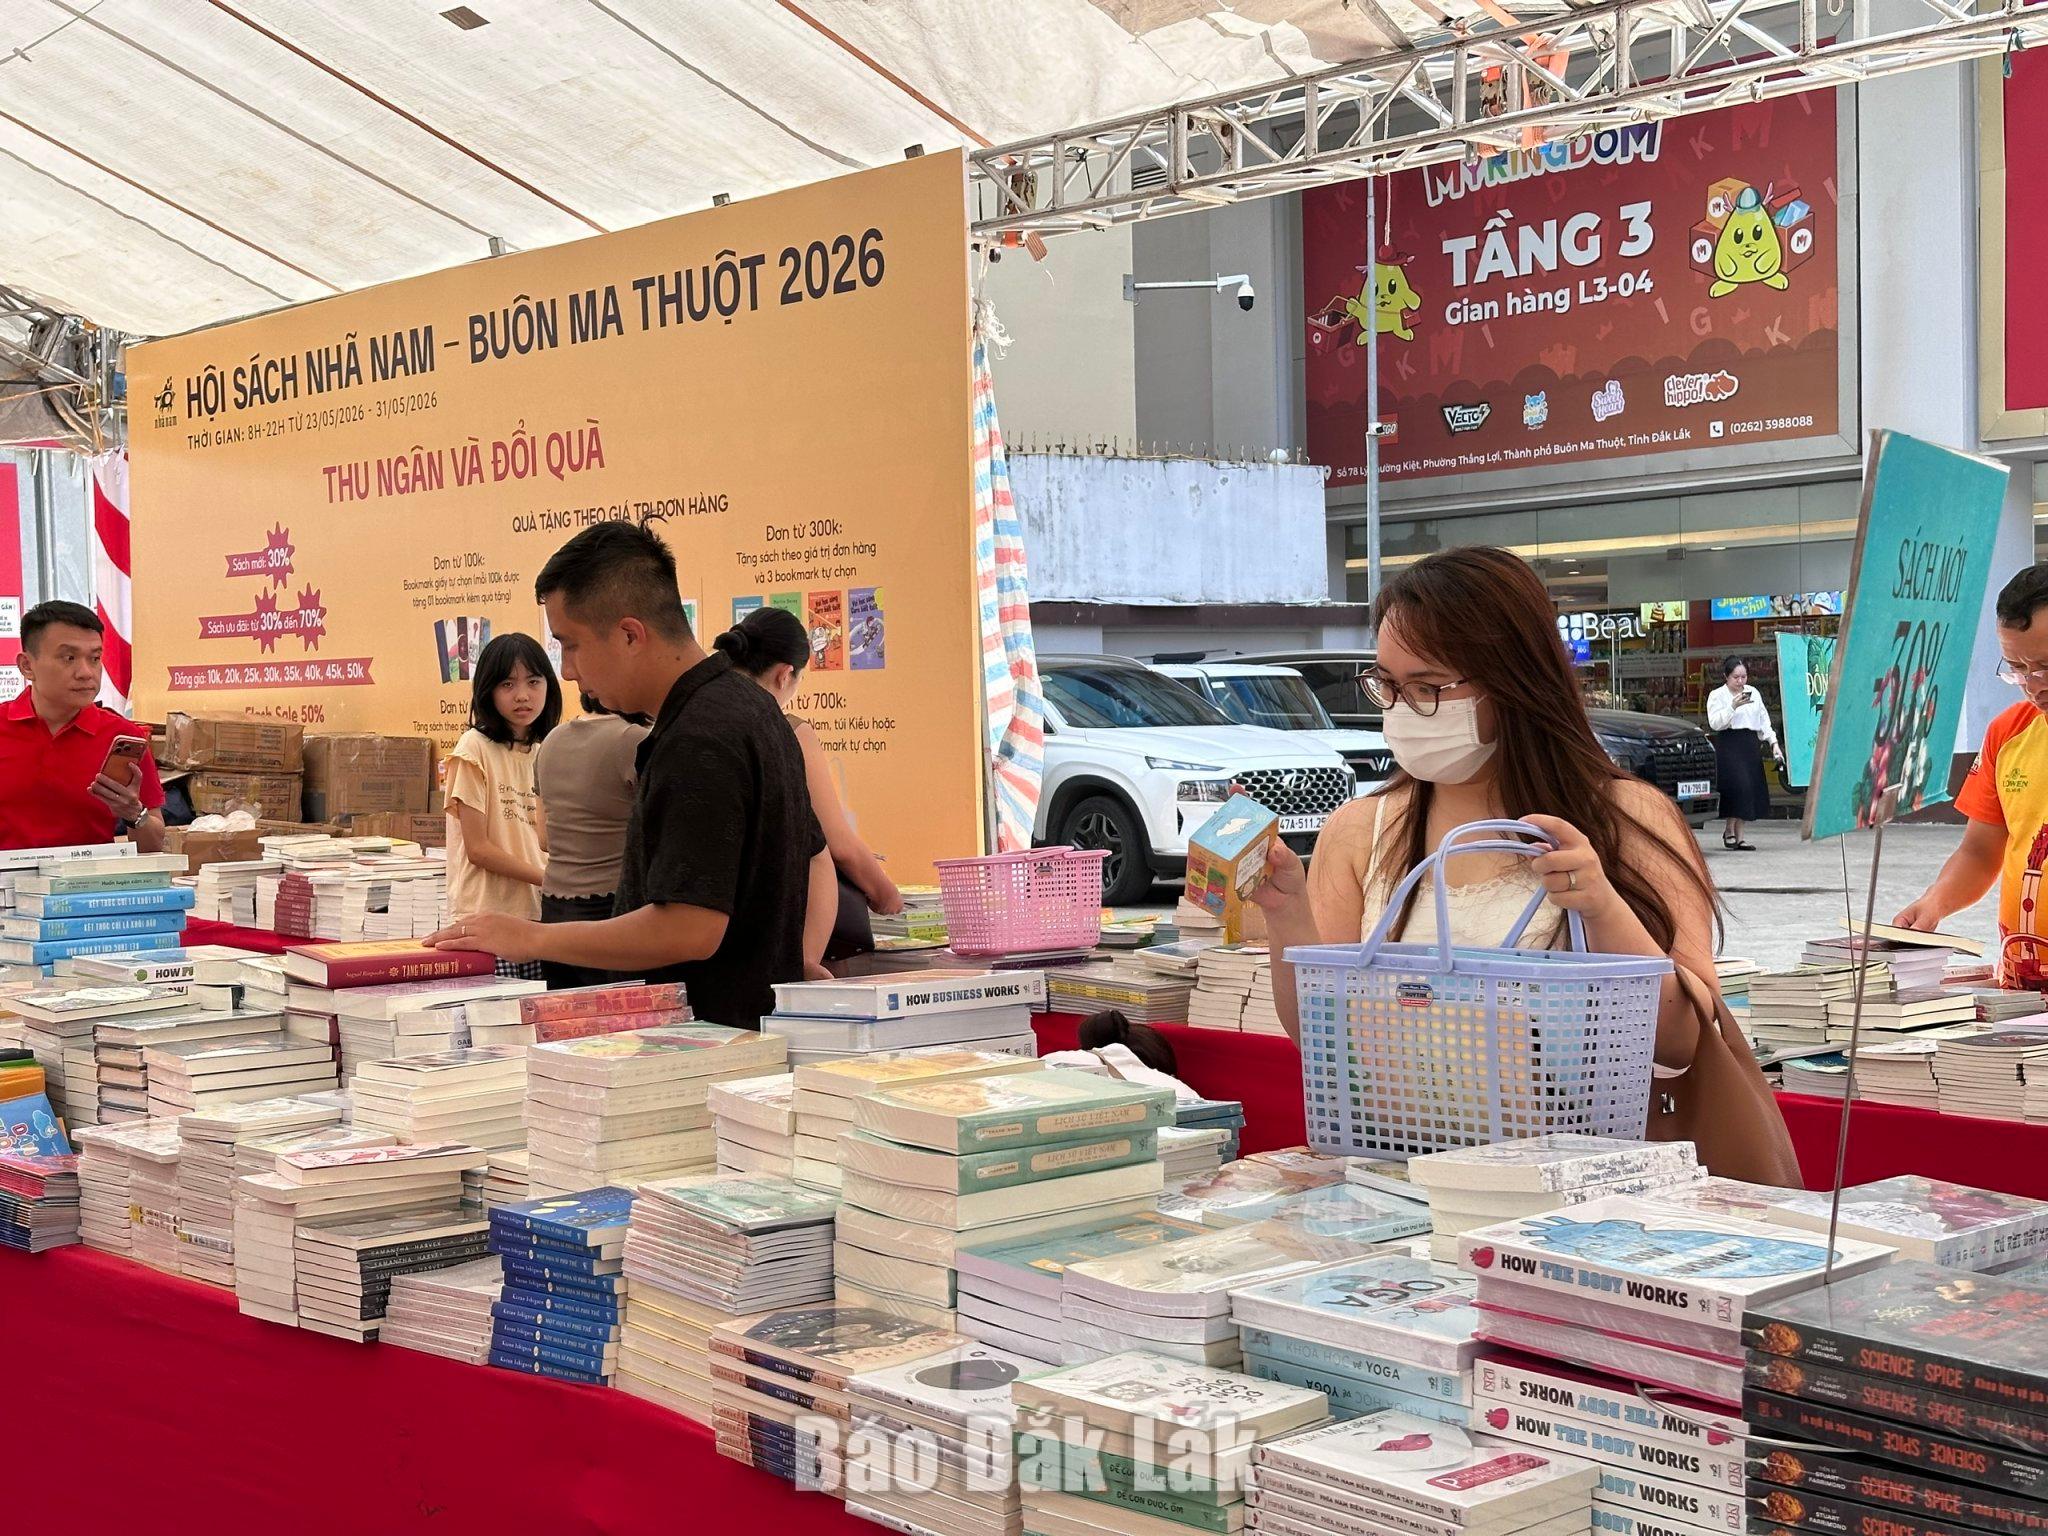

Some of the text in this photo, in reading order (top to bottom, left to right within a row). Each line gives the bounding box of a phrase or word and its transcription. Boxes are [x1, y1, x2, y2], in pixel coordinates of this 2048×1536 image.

[1443, 201, 1654, 287] TẦNG 3
[1445, 269, 1654, 325] Gian hàng L3-04
[187, 227, 885, 422] HỘI SÁCH NHÃ NAM BUÔN MA THUỘT 2026
[188, 391, 438, 450] THỜI GIAN: 8H-22H TỪ 23/05/2026 31/05/2026
[1424, 454, 1457, 470] Phường
[1458, 451, 1485, 468] Thắng
[1504, 445, 1532, 459] Thành
[1534, 442, 1551, 459] phố
[1553, 442, 1577, 454] Buôn
[1580, 440, 1595, 450] Ma
[1596, 436, 1626, 450] Thuột,
[1628, 432, 1649, 446] Tỉnh
[1652, 428, 1672, 443] Đắk
[1673, 426, 1691, 441] Lắk
[1730, 421, 1763, 435] (0262)
[1765, 416, 1813, 430] 3988088
[323, 418, 605, 504] THU NGÂN VÀ ĐỔI QUÀ
[512, 514, 537, 533] QUÀ
[539, 508, 571, 534] TẶNG
[574, 506, 605, 526] THEO
[609, 499, 630, 522] GIÁ
[655, 497, 685, 519] ĐƠN
[689, 494, 729, 515] HÀNG
[766, 519, 843, 541] Đơn từ 300k:
[233, 547, 290, 572] Sách 30%
[434, 553, 485, 570] Đơn từ 100k:
[737, 541, 877, 567] Tặng sách theo giá trị đơn hàng
[1892, 526, 1968, 603] SÁCH MỚI
[403, 577, 433, 591] Bookmark
[755, 565, 857, 584] và 3 bookmark tự chọn
[208, 620, 224, 634] Sách
[260, 612, 282, 631] 30%
[284, 615, 298, 630] đến
[299, 608, 322, 629] 70%
[225, 668, 242, 684] 20k,
[244, 667, 262, 684] 25k,
[264, 666, 282, 683] 30k,
[284, 665, 302, 682] 35k,
[304, 664, 323, 681] 40k,
[326, 663, 344, 680] 45k,
[347, 662, 364, 679] 50k
[440, 699, 468, 714] Đơn từ
[797, 693, 811, 710] từ
[813, 692, 847, 709] 700k:
[301, 705, 325, 723] 50%
[808, 713, 896, 732] Nam, túi Kiều hoặc
[850, 738, 860, 754] tự
[863, 738, 886, 752] chọn
[156, 968, 180, 978] HOW
[906, 984, 1020, 1007] HOW BUSINESS WORKS
[1501, 1253, 1688, 1308] HOW THE BODY WORKS
[1806, 1349, 1844, 1362] FARRIMOND
[1813, 1343, 1838, 1353] STUART
[1366, 1361, 1400, 1381] YOGA
[1860, 1348, 1964, 1389] SCIENCE SPICE
[1306, 1379, 1338, 1397] YOGA
[1815, 1380, 1841, 1390] STUART
[1520, 1381, 1700, 1437] WORKS BODY THE HOW
[1862, 1386, 1966, 1427] SCIENCE SPICE
[1516, 1415, 1700, 1473] HOW THE BODY WORKS
[1883, 1431, 1987, 1473] SCIENCE SPICE
[1600, 1474, 1699, 1514] BODY WORKS
[1860, 1475, 1961, 1515] SCIENCE SPICE
[1809, 1517, 1847, 1531] FARRIMOND
[1815, 1511, 1840, 1522] STUART
